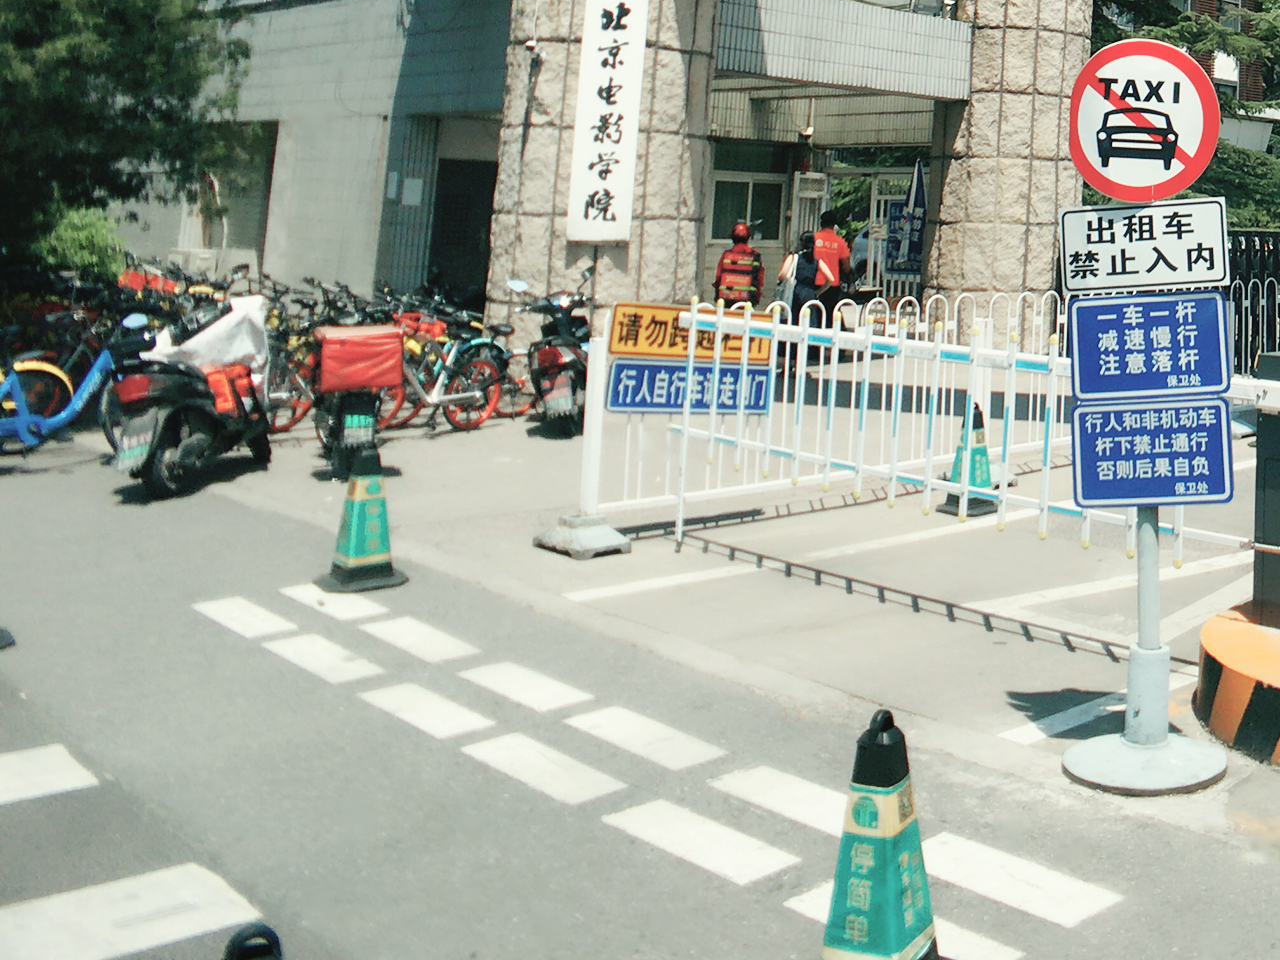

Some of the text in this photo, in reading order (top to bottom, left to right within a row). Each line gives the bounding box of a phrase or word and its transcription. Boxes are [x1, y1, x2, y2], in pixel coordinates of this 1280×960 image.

[1098, 77, 1180, 104] TAXI
[583, 1, 632, 222] 北京电影学院
[1086, 211, 1194, 244] 出租车
[1069, 242, 1215, 280] 禁止入内
[1096, 300, 1197, 326] 一车一杆
[1097, 325, 1198, 352] 减速慢行
[1098, 348, 1200, 376] 注意落杆
[1166, 373, 1202, 388] 保卫处
[1085, 407, 1217, 434] 行人和非机动车
[1095, 431, 1209, 457] 杆下禁止通行
[1096, 456, 1210, 481] 否则后果自负
[1174, 481, 1209, 495] 保卫处
